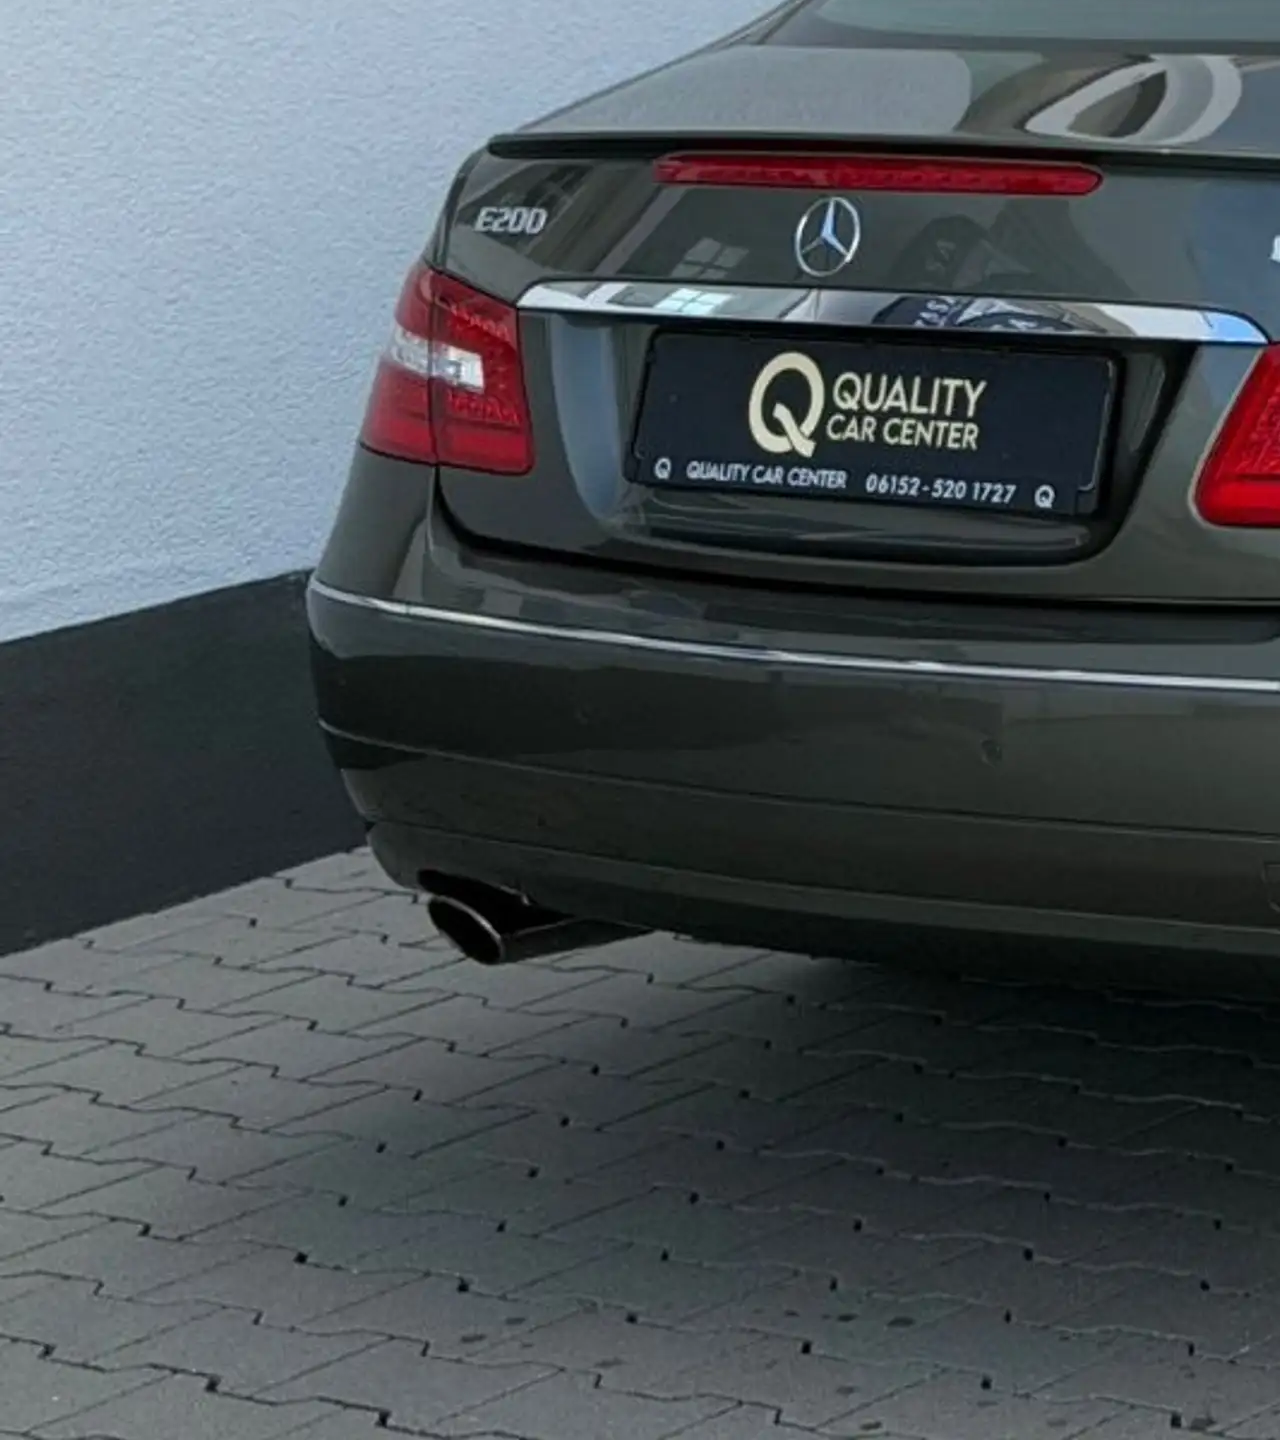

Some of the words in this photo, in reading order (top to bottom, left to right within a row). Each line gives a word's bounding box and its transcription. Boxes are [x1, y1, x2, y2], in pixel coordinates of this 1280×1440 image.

[473, 205, 549, 235] E200
[747, 350, 826, 458] Q
[832, 371, 988, 418] QUALITY
[825, 413, 878, 443] CAR
[882, 417, 980, 451] CENTER
[654, 457, 672, 480] Q
[685, 461, 751, 482] QUALITY
[752, 465, 784, 485] CAR
[787, 467, 848, 489] CENTER
[971, 481, 1017, 504] 1727
[1034, 484, 1056, 509] Q
